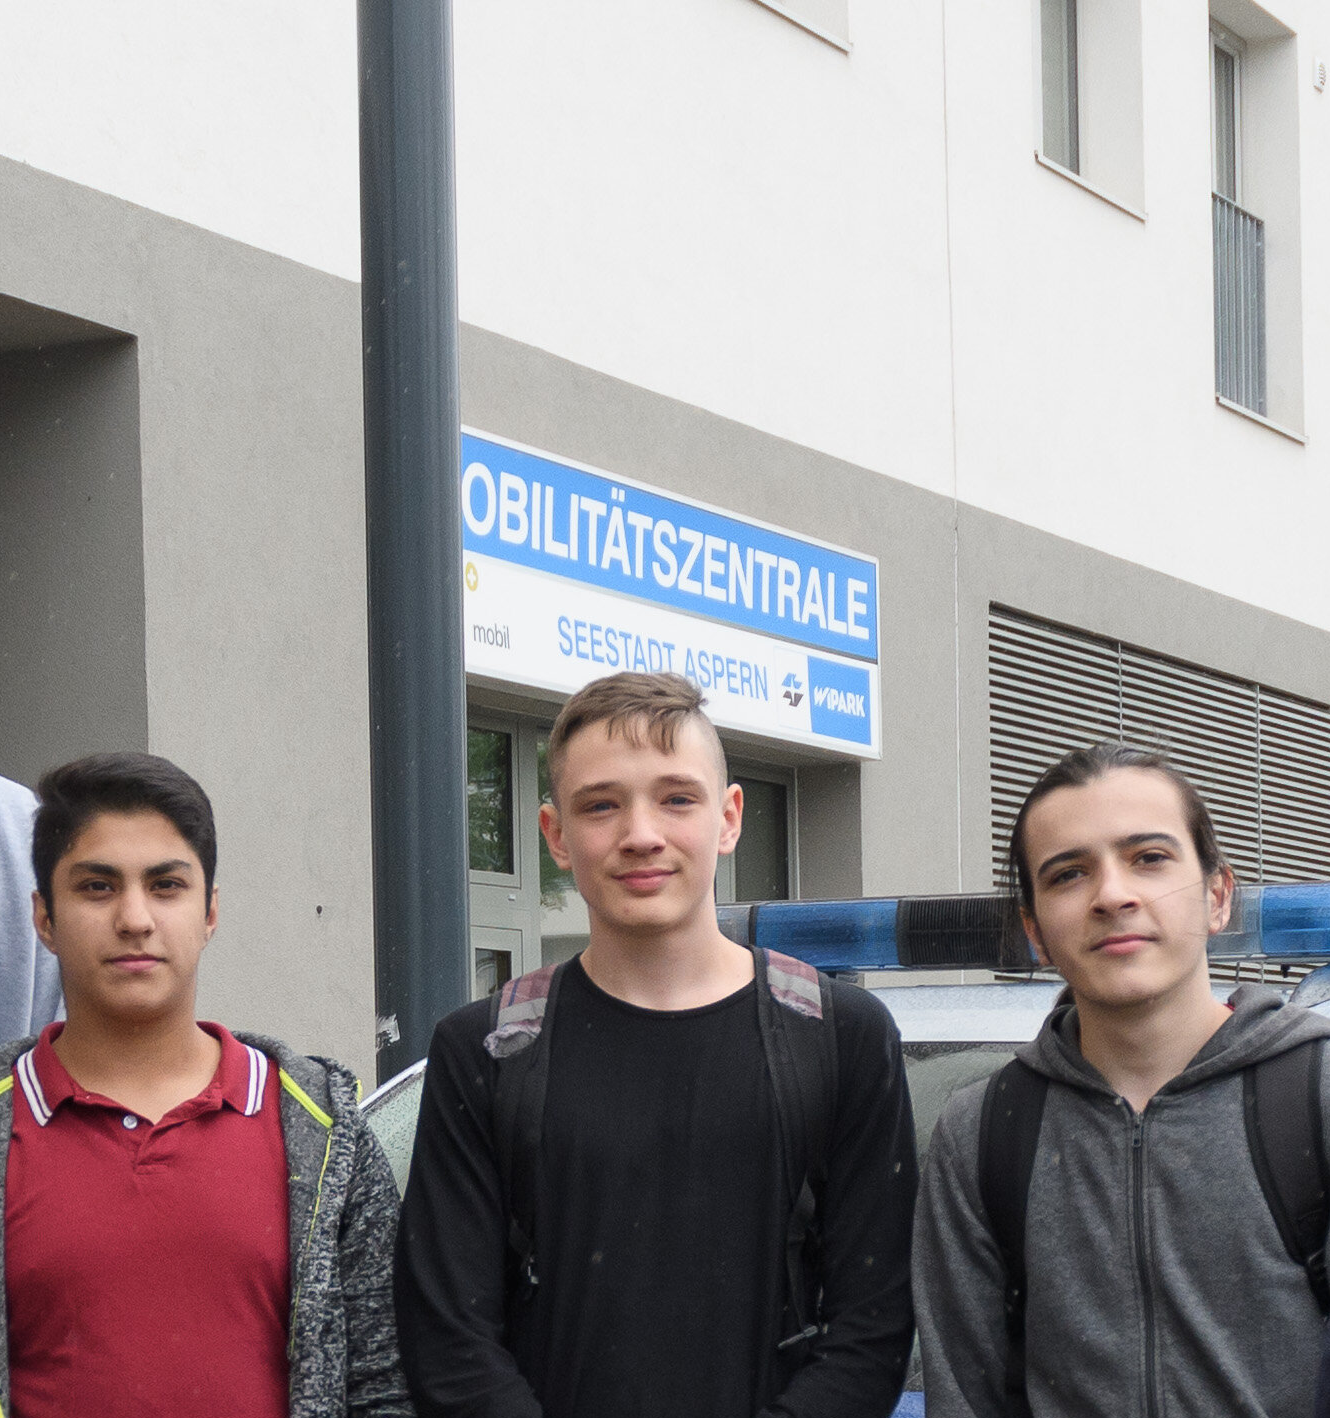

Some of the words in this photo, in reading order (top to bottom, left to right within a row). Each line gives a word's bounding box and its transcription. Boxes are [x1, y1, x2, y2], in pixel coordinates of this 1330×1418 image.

[461, 462, 870, 640] OBILITÄTSZENTRALE
[472, 623, 511, 650] mobil
[557, 616, 675, 673] SEESTADT
[684, 647, 769, 701] ASPERN
